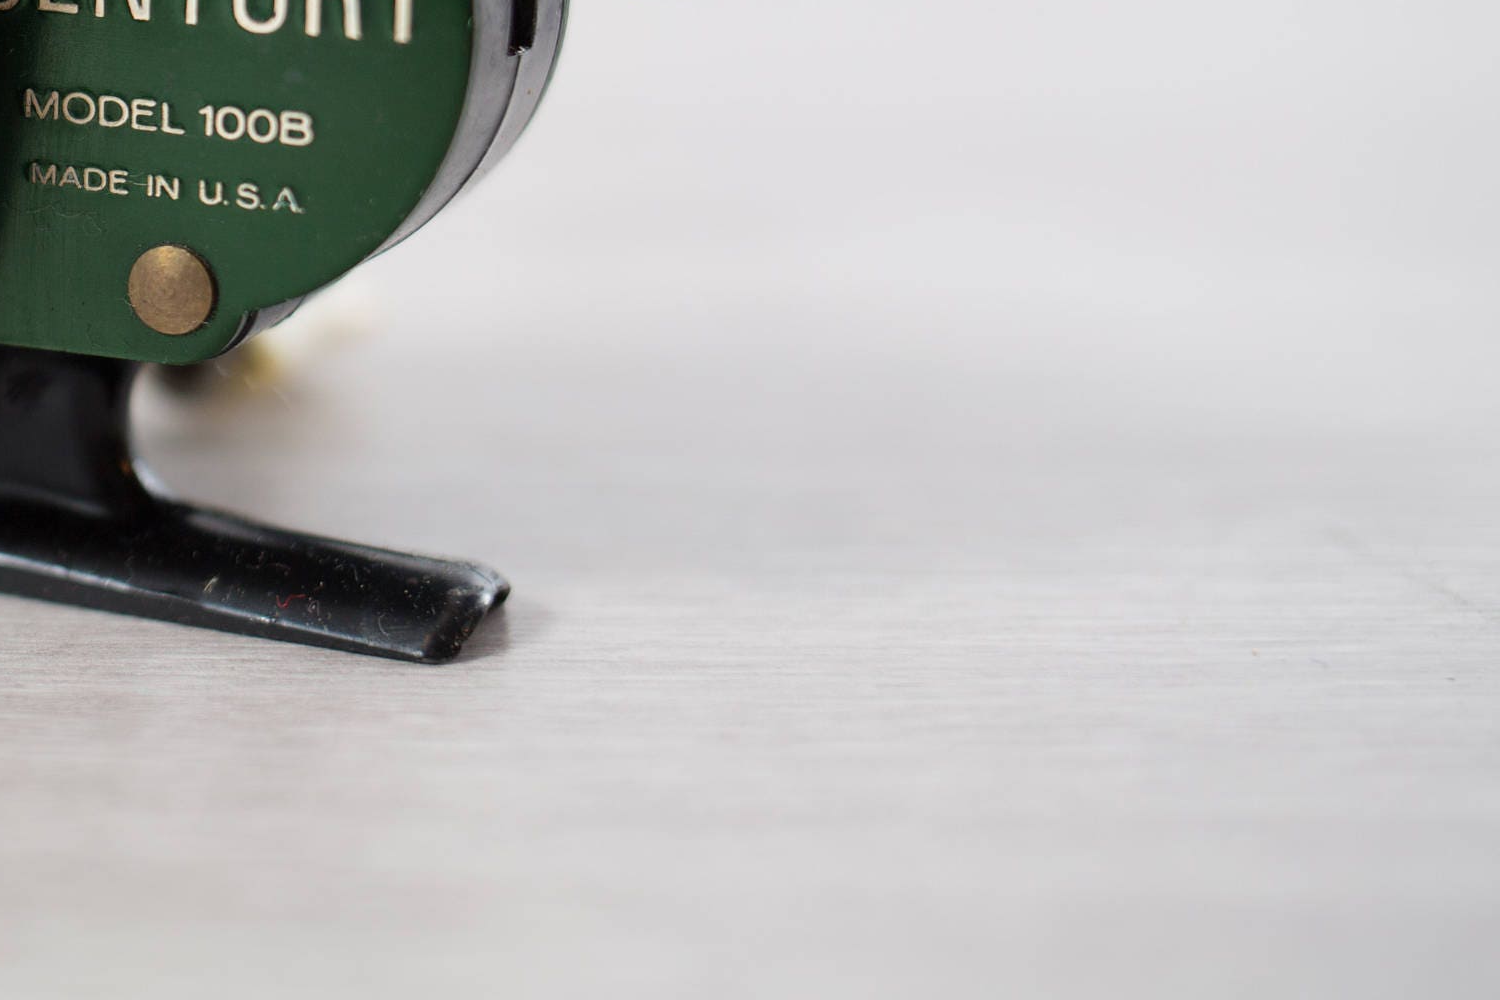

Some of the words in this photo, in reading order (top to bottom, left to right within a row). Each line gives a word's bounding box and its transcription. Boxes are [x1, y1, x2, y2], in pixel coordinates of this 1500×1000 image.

[23, 88, 186, 136] MODEL
[197, 104, 315, 147] 100B
[29, 161, 130, 195] MADE
[146, 173, 181, 201] IN
